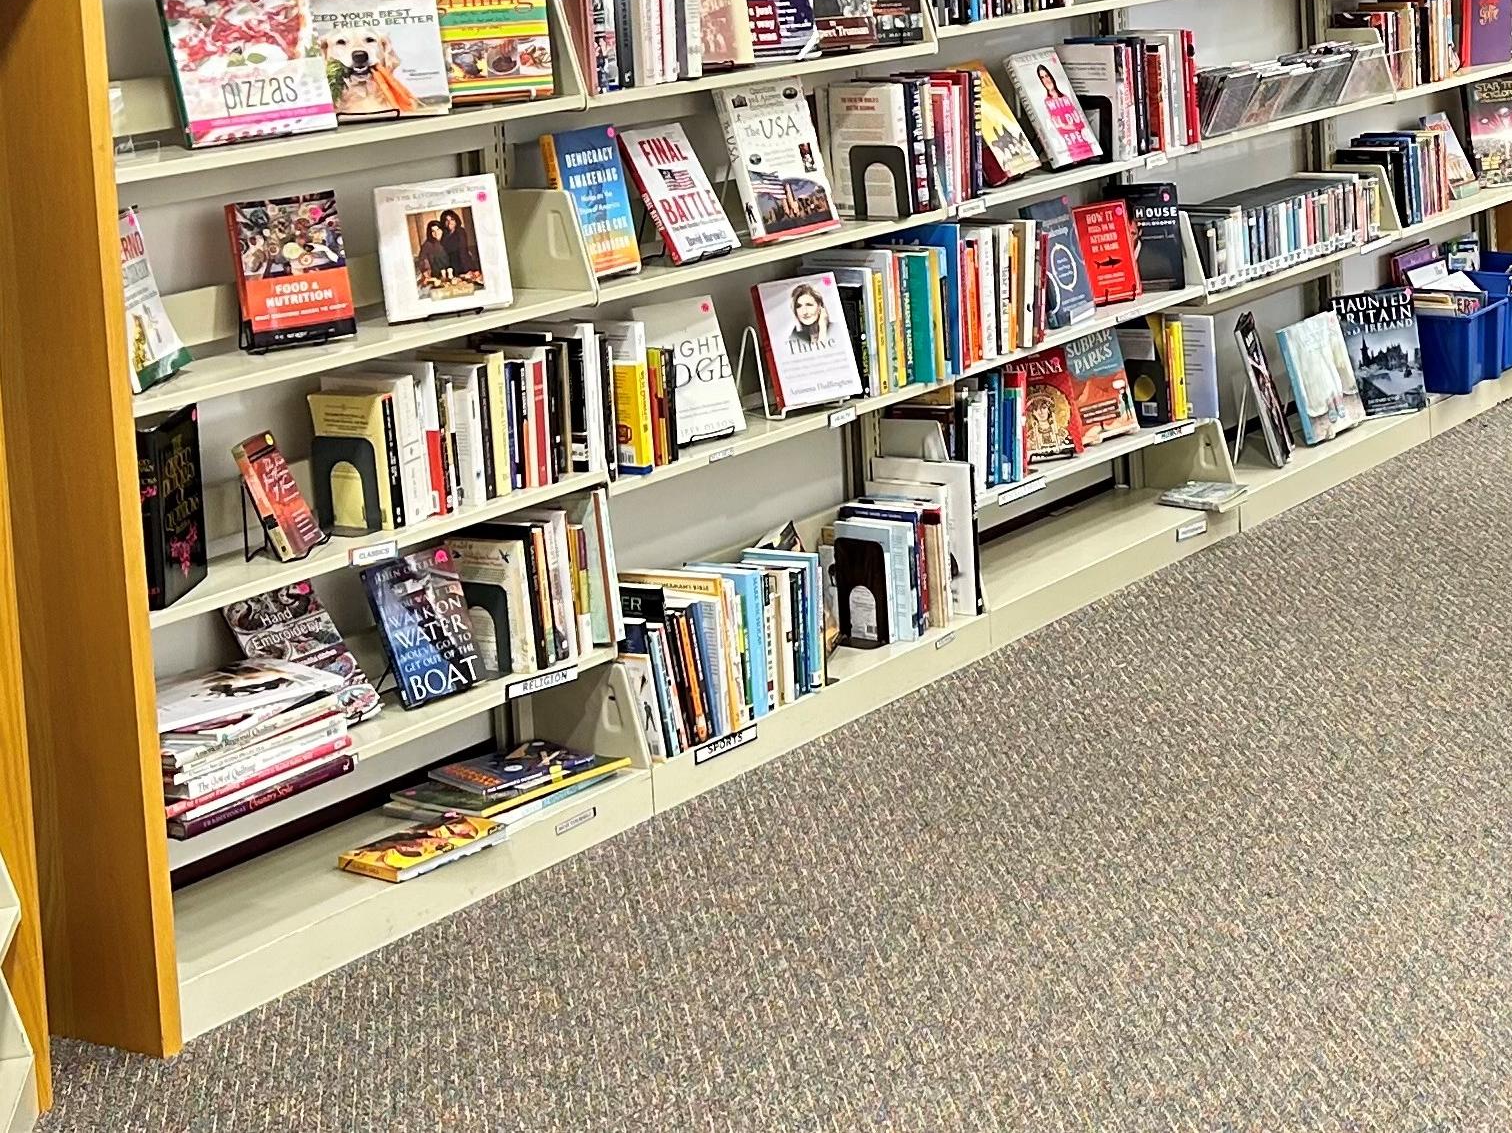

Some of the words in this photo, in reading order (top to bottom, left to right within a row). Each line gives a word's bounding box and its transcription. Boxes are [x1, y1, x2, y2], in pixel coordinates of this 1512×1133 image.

[332, 16, 381, 30] FRIEND
[384, 14, 434, 26] BETTER
[340, 12, 375, 21] YOUR
[377, 8, 412, 19] BEST
[220, 74, 299, 116] pizzas
[758, 114, 801, 140] USA
[564, 145, 613, 168] DEMOCRACY
[637, 136, 689, 167] FINAL
[568, 171, 619, 190] AWAKENING
[656, 188, 720, 226] BATTLE
[1135, 206, 1178, 219] HOUSE
[265, 287, 334, 309] NUTRITION
[275, 281, 310, 295] FOOD
[1331, 292, 1412, 315] HAUNTED
[785, 338, 837, 356] Thrive
[1065, 327, 1113, 359] SUBPAR
[1073, 342, 1114, 375] PARKS
[259, 607, 294, 627] Hand
[251, 617, 322, 651] Embroidery
[393, 612, 469, 650] WATER
[408, 654, 479, 701] BOAT
[521, 669, 568, 693] RELIGION
[706, 731, 744, 754] SPORTS
